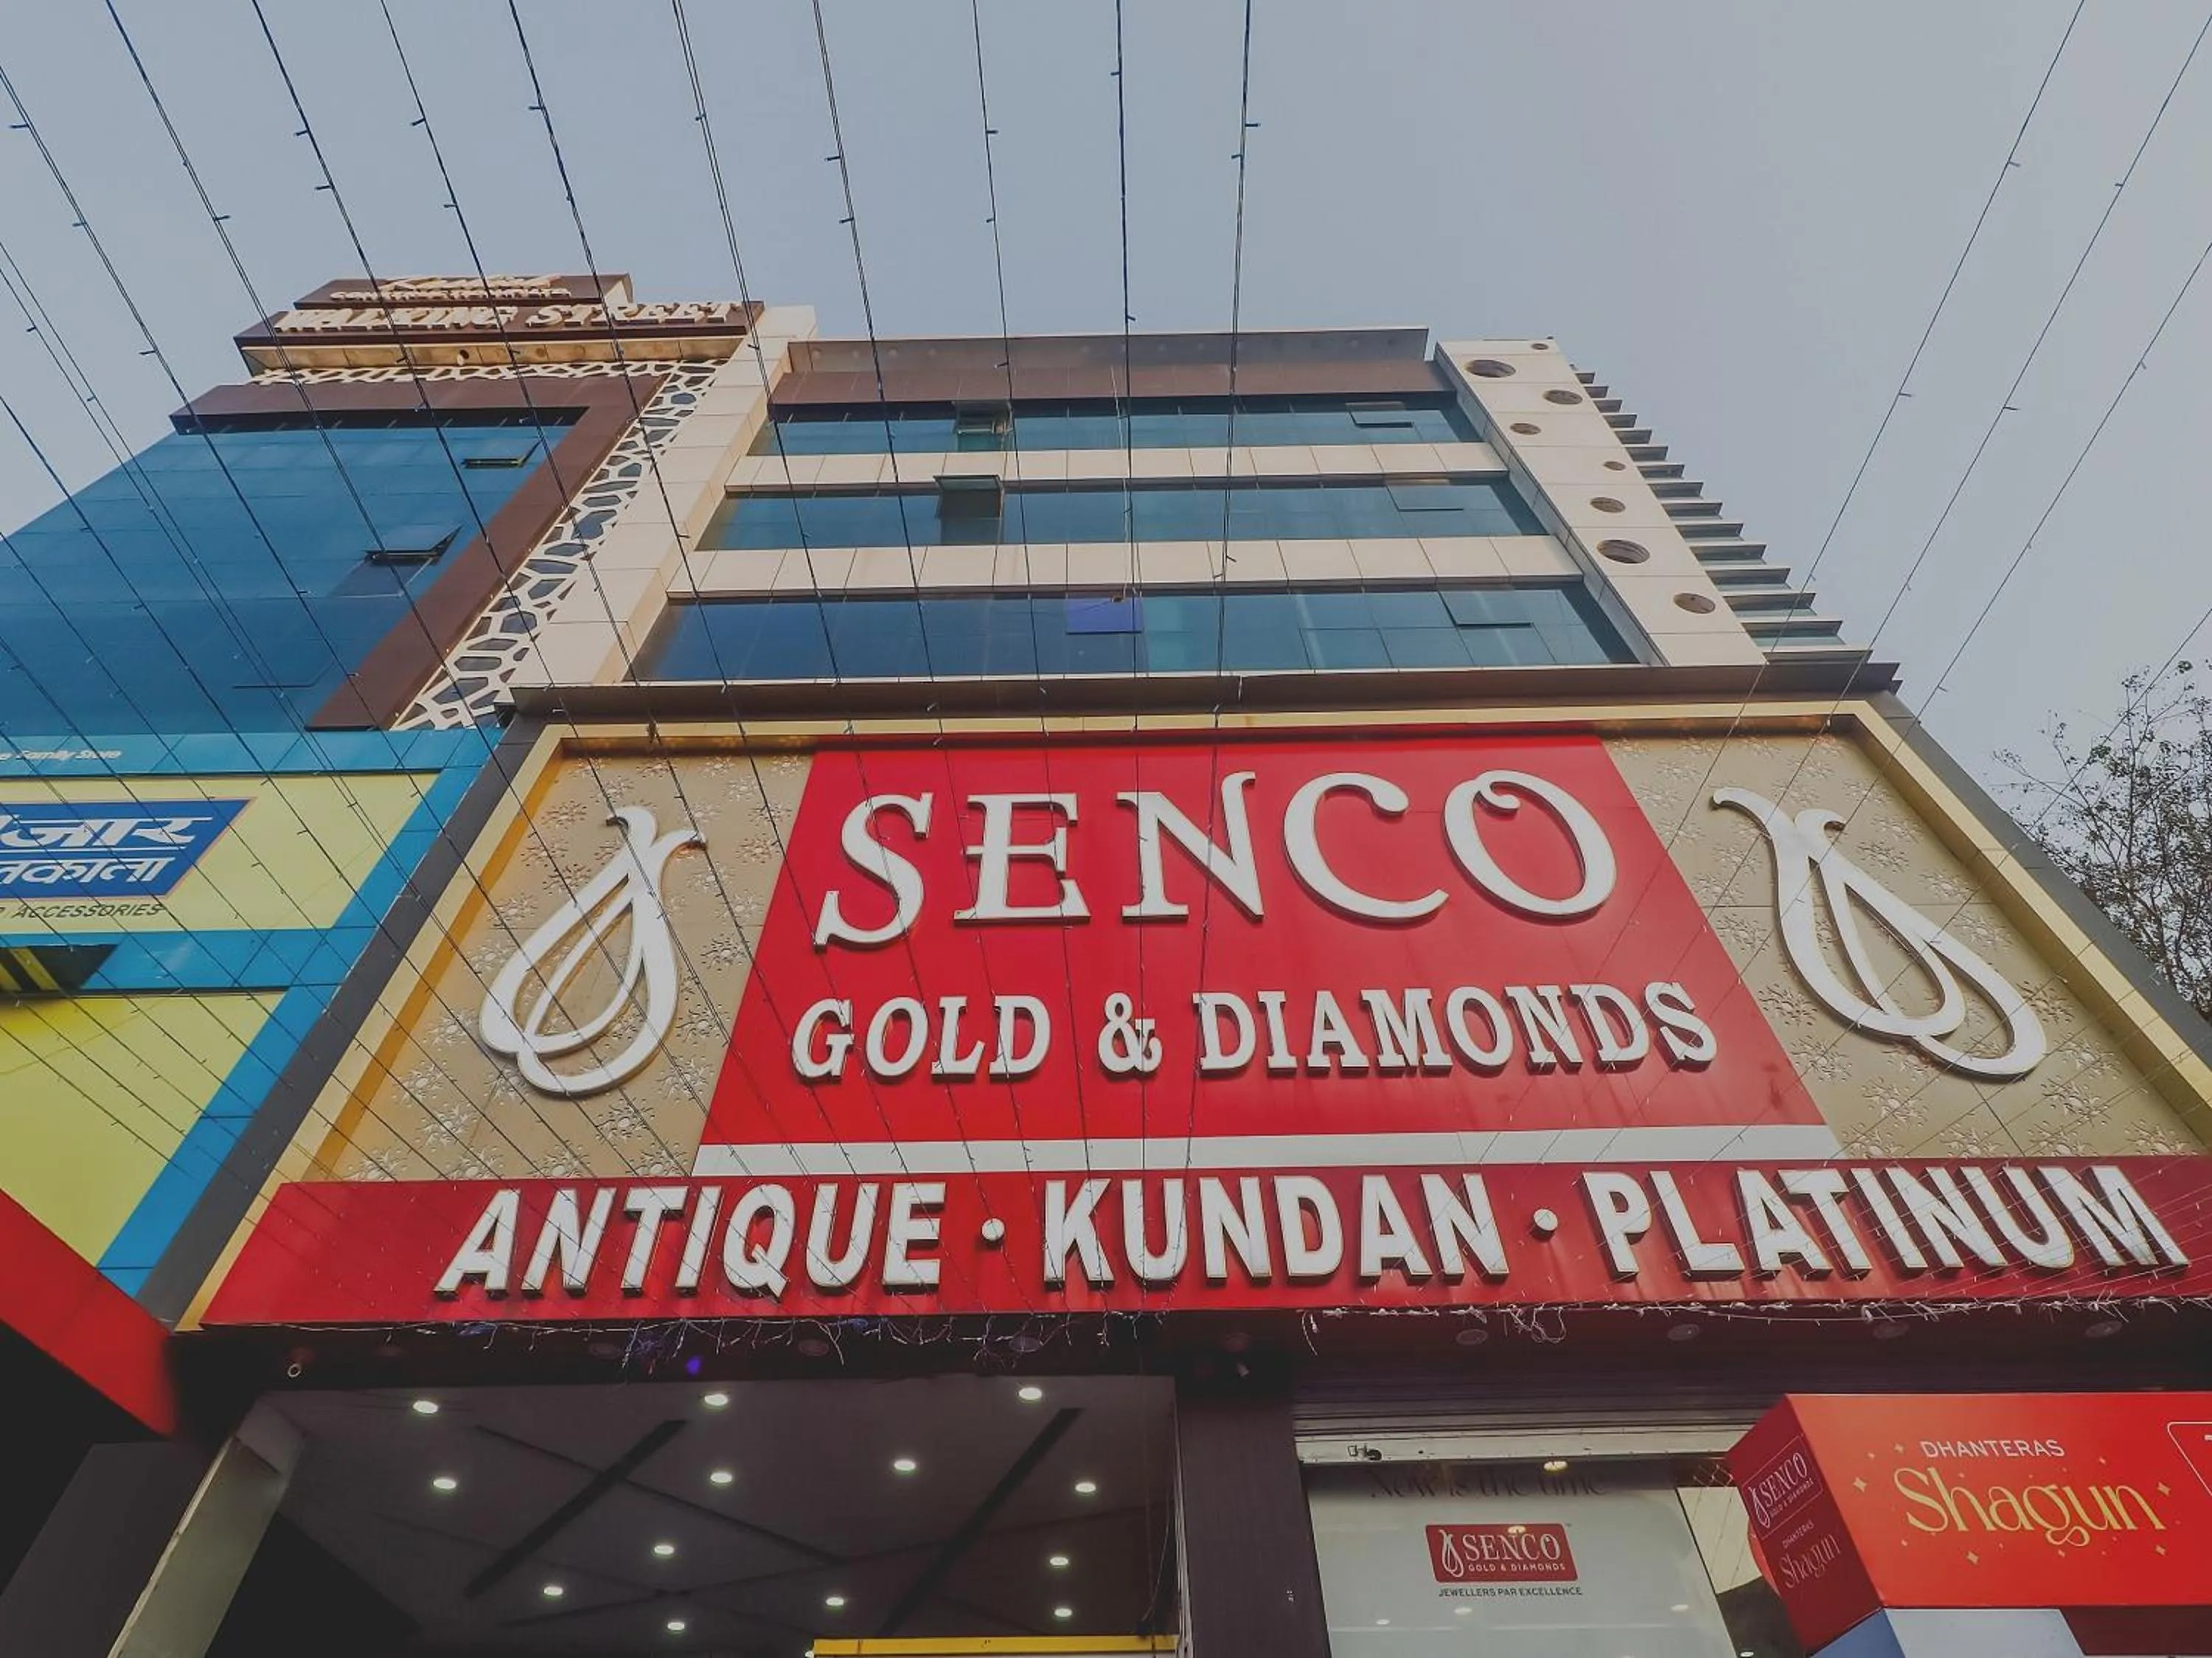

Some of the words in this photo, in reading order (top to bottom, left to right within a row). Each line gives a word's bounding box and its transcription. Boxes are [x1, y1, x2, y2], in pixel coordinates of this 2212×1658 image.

[526, 300, 741, 328] STREET
[75, 749, 122, 760] Store
[813, 769, 1618, 948] SENCO
[11, 903, 166, 918] ACCESSORIES
[791, 993, 1051, 1080] GOLD
[1097, 991, 1162, 1075] &
[1192, 980, 1719, 1077] DIAMONDS
[434, 1182, 946, 1300] ANTIQUE
[1043, 1171, 1509, 1285] KUNDAN
[1582, 1164, 2191, 1277] PLATINUM
[1920, 1439, 2065, 1459] DHANTERAS
[1759, 1452, 1808, 1507] SENCO
[1893, 1466, 2168, 1547] Shagun
[1462, 1533, 1561, 1561] SENCO
[1780, 1533, 1841, 1589] Shagun
[1468, 1563, 1496, 1572] GOLD
[1500, 1563, 1506, 1572] &
[1511, 1563, 1566, 1572] DIAMONDS
[1439, 1588, 1496, 1597] JEWELLERS
[1498, 1588, 1517, 1596] PAR
[1519, 1586, 1582, 1596] EXCELLENCE
